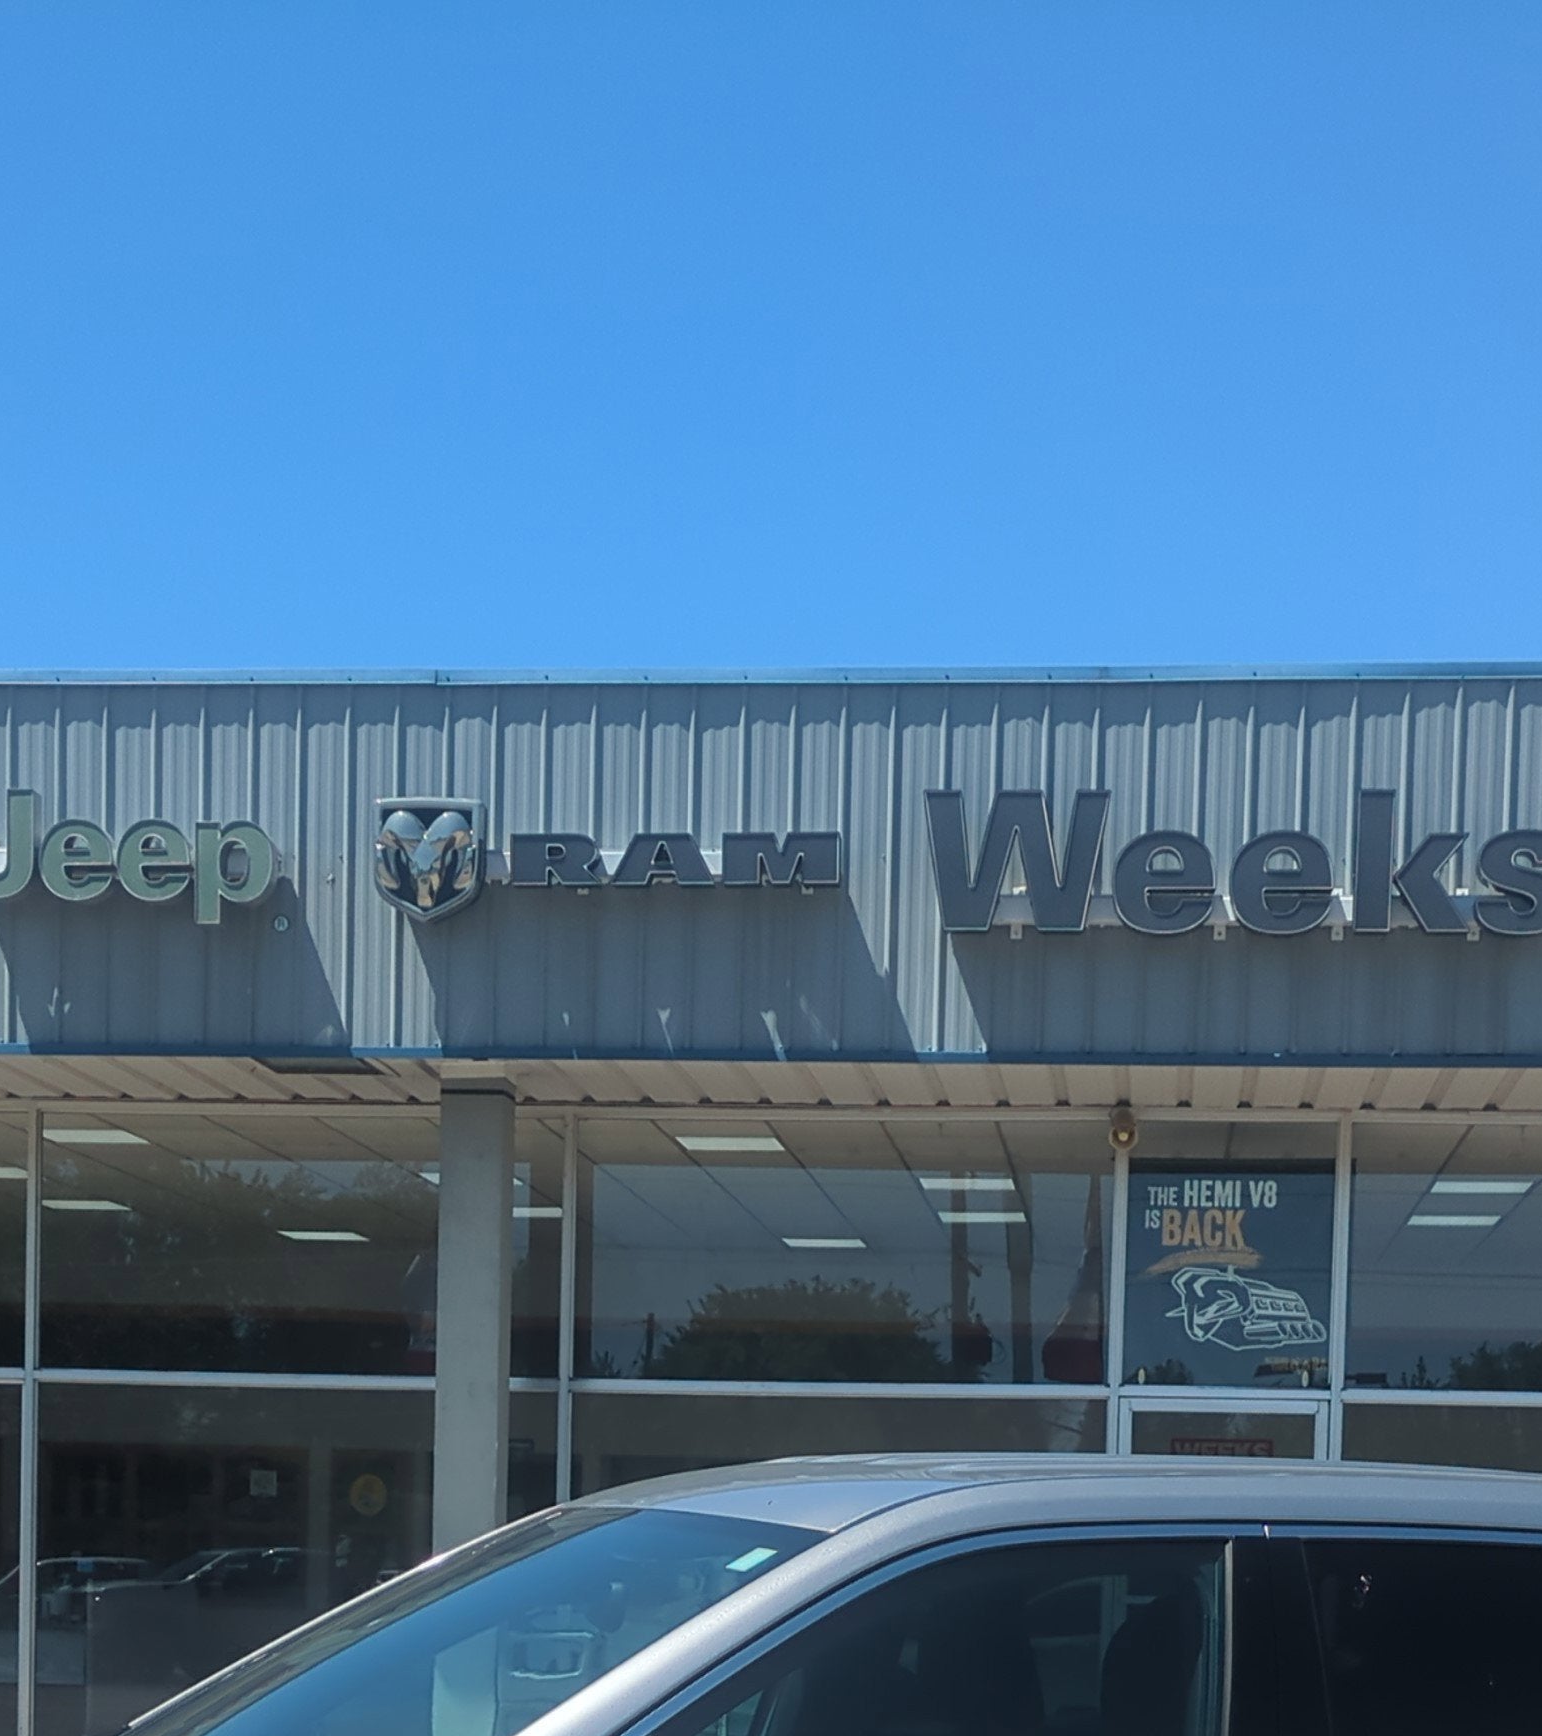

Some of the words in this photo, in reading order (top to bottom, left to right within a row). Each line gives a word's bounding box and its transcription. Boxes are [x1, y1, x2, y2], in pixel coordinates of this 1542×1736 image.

[510, 832, 843, 887] RAM
[1147, 1186, 1178, 1206] THE
[1183, 1179, 1242, 1208] HEMI
[1248, 1180, 1278, 1209] V8
[1144, 1209, 1161, 1230] IS
[1161, 1208, 1246, 1250] BACK
